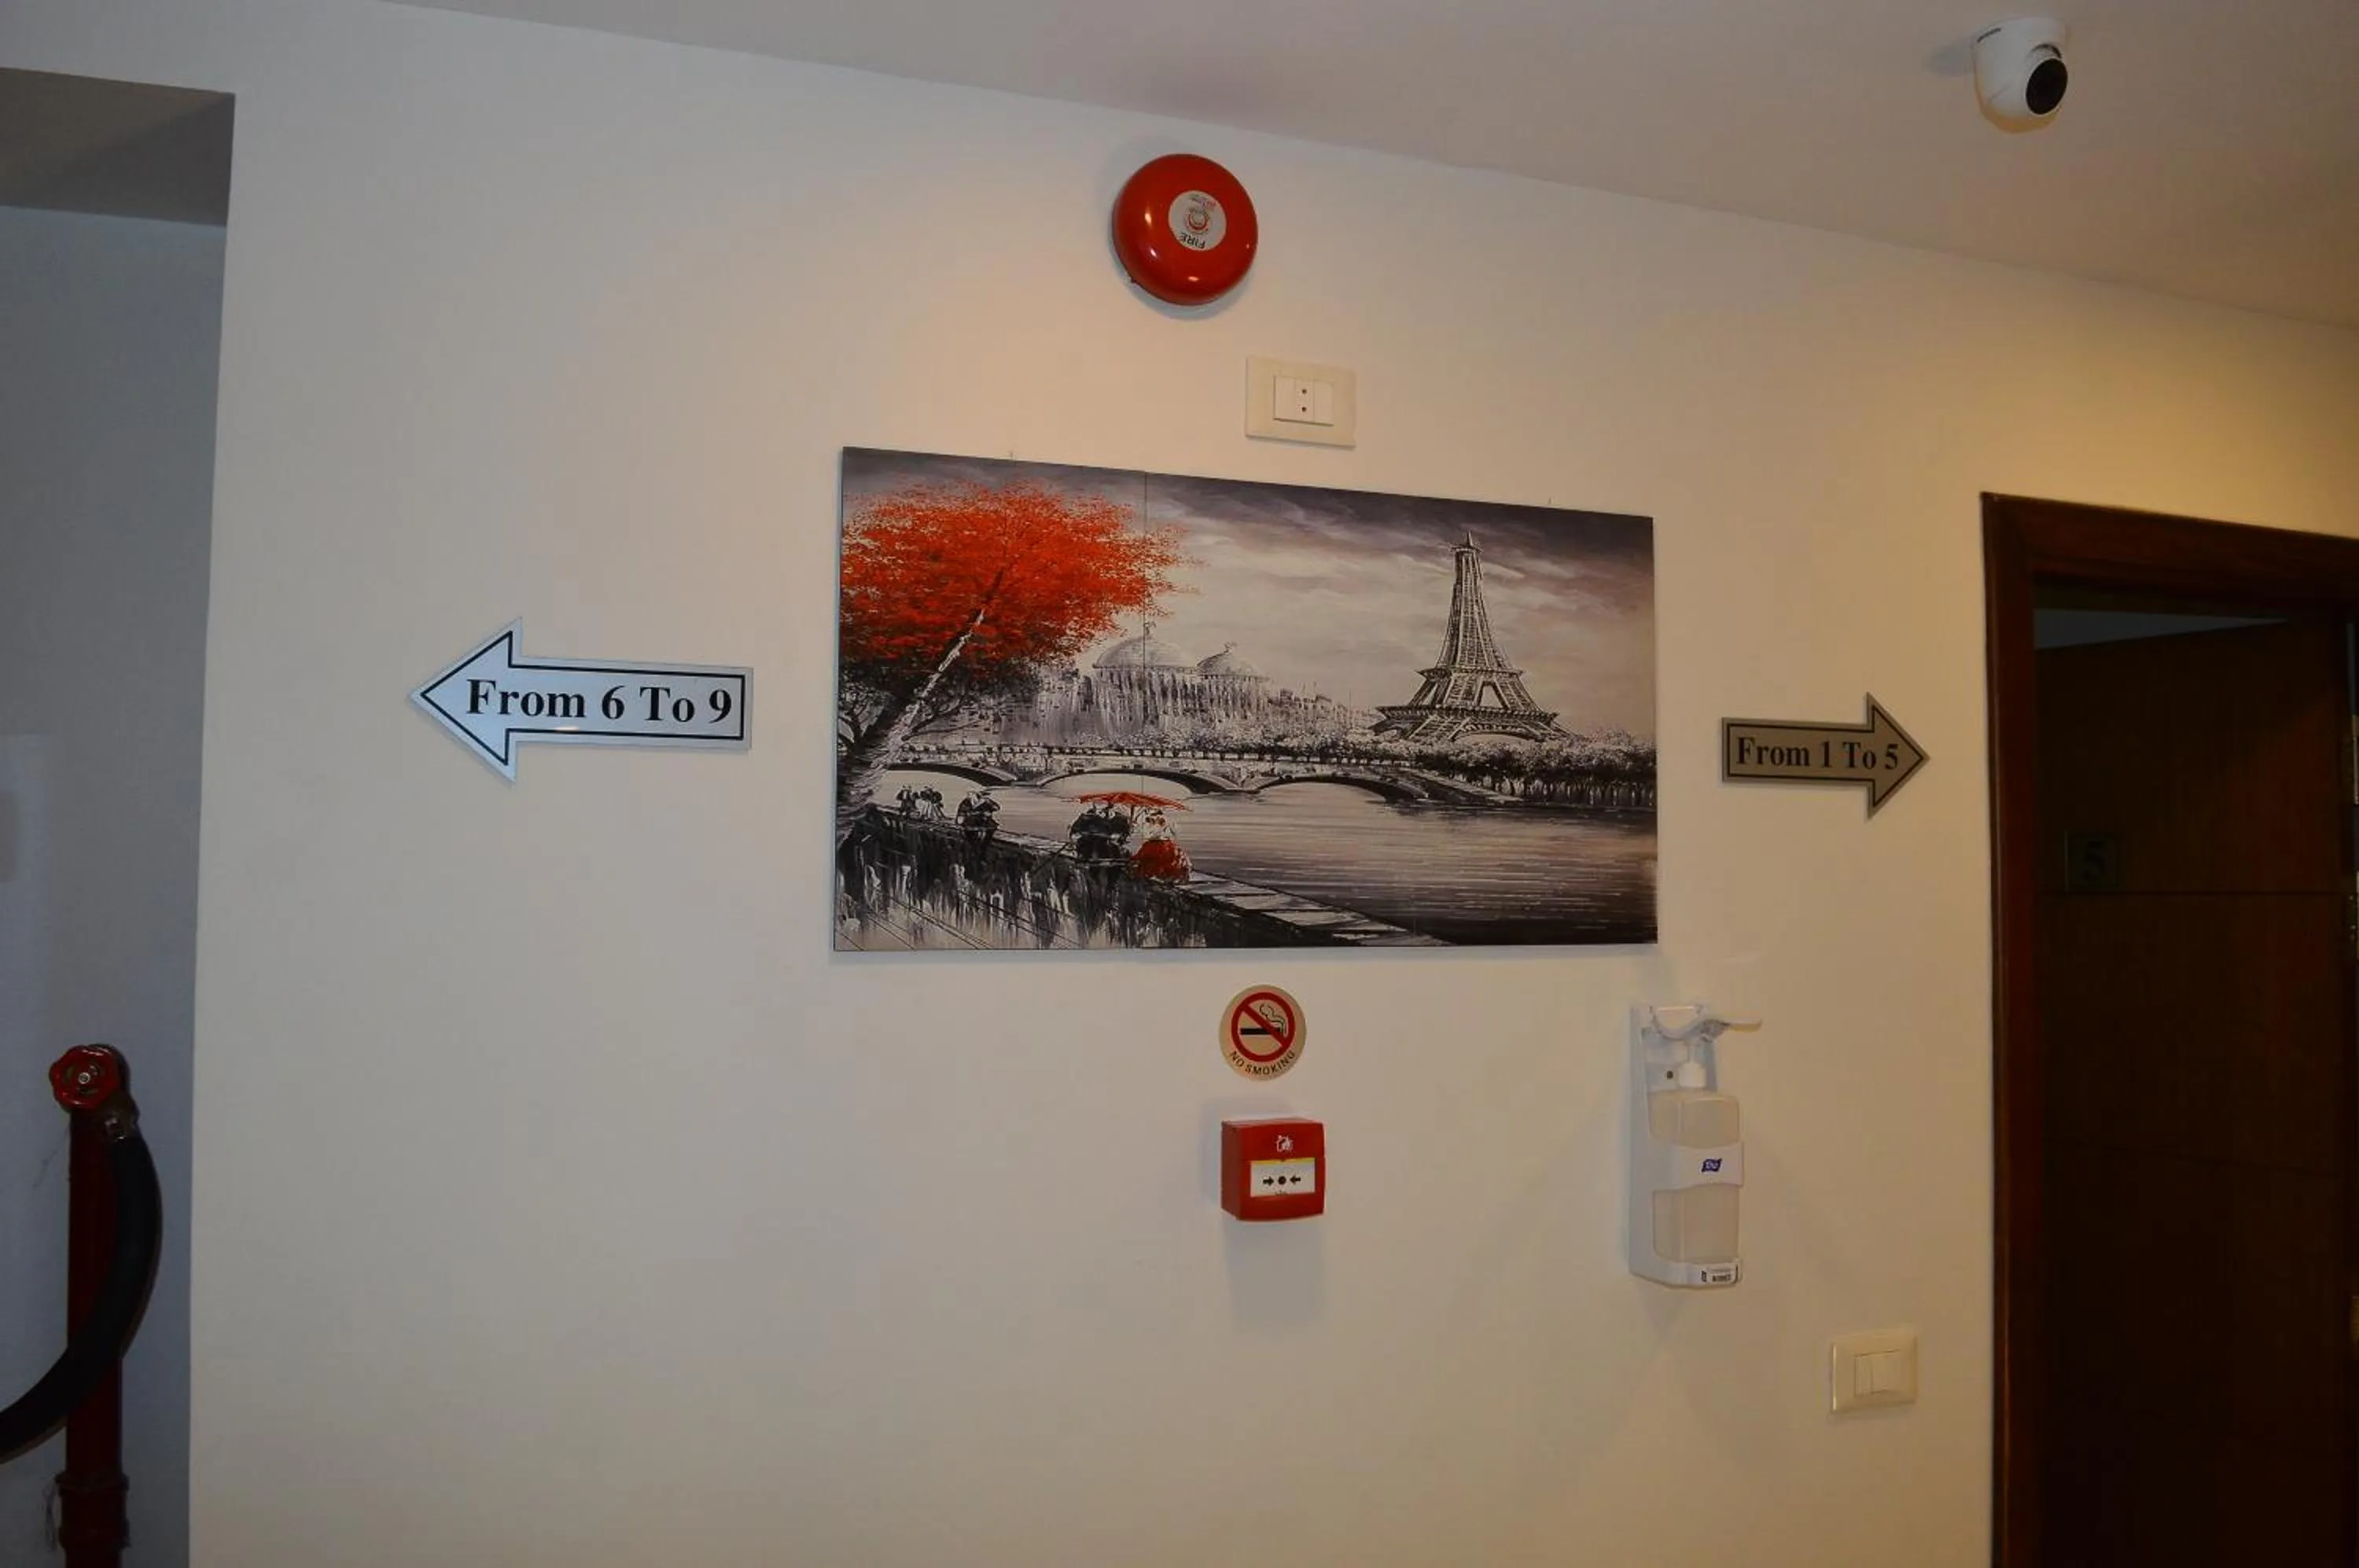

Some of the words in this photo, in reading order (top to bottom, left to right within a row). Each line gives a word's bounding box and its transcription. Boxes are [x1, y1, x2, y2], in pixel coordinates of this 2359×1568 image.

[1179, 232, 1205, 248] FIRE
[466, 679, 587, 718] From
[601, 685, 626, 720] 6
[639, 686, 696, 722] To
[708, 689, 732, 723] 9
[1736, 736, 1811, 767] From
[1820, 741, 1833, 767] 1
[1843, 741, 1877, 769] To
[1885, 743, 1899, 770] 5
[2081, 838, 2106, 882] 5
[1229, 1051, 1245, 1067] NO
[1246, 1050, 1295, 1075] SMOKING
